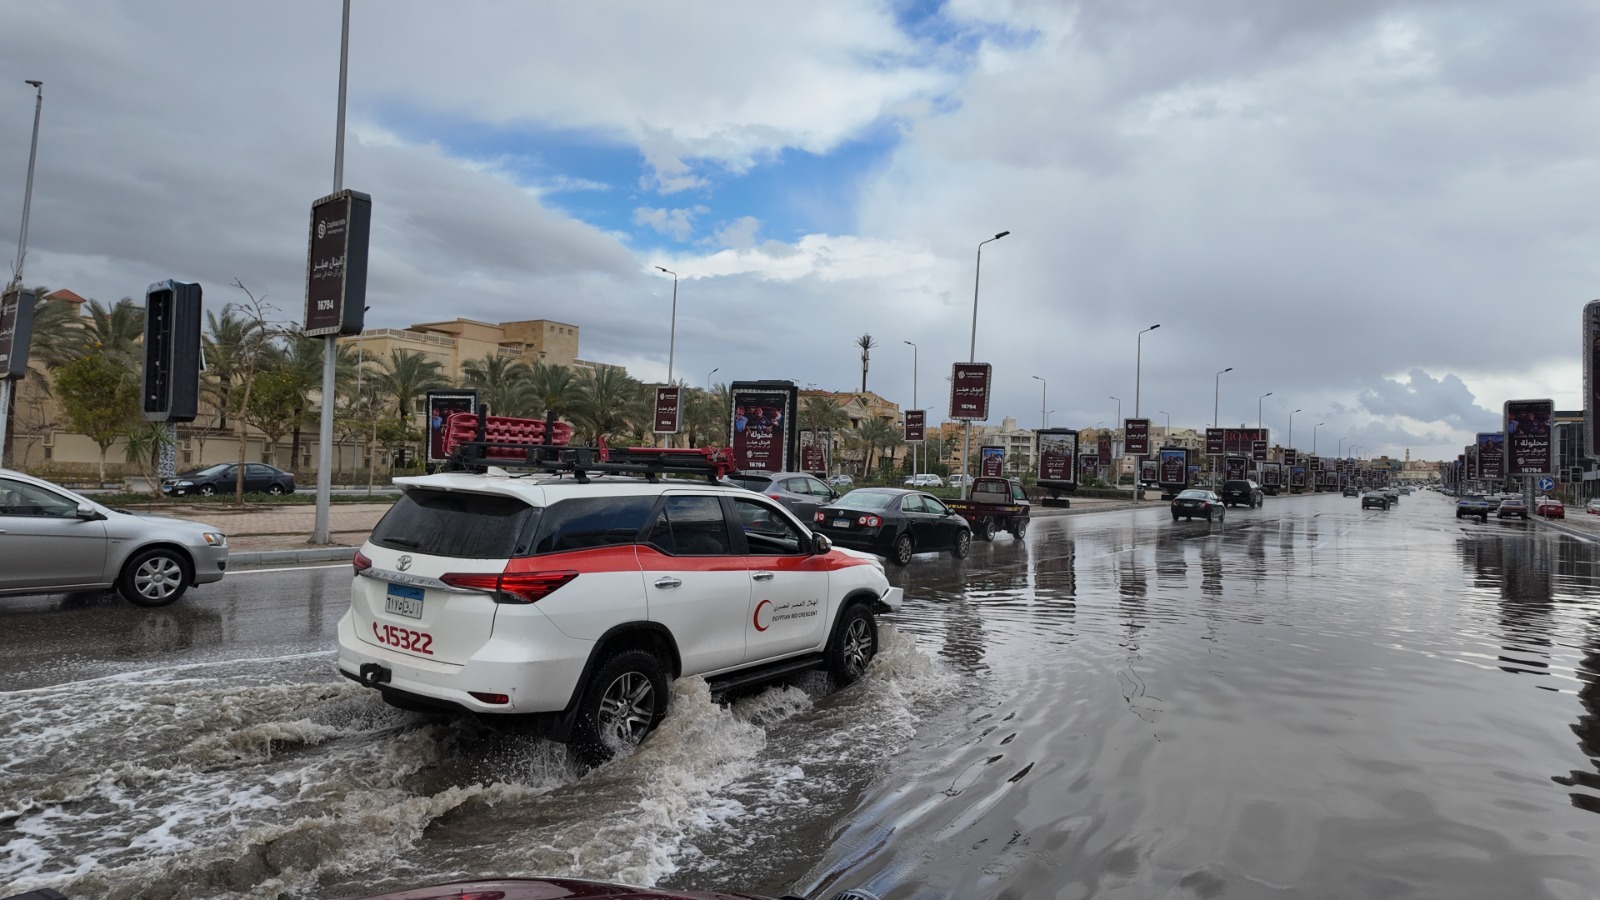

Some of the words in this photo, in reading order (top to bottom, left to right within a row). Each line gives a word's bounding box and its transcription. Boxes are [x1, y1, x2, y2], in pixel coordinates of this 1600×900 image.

[318, 300, 334, 310] 16794
[1520, 439, 1548, 447] محلولة
[383, 625, 433, 655] 15322
